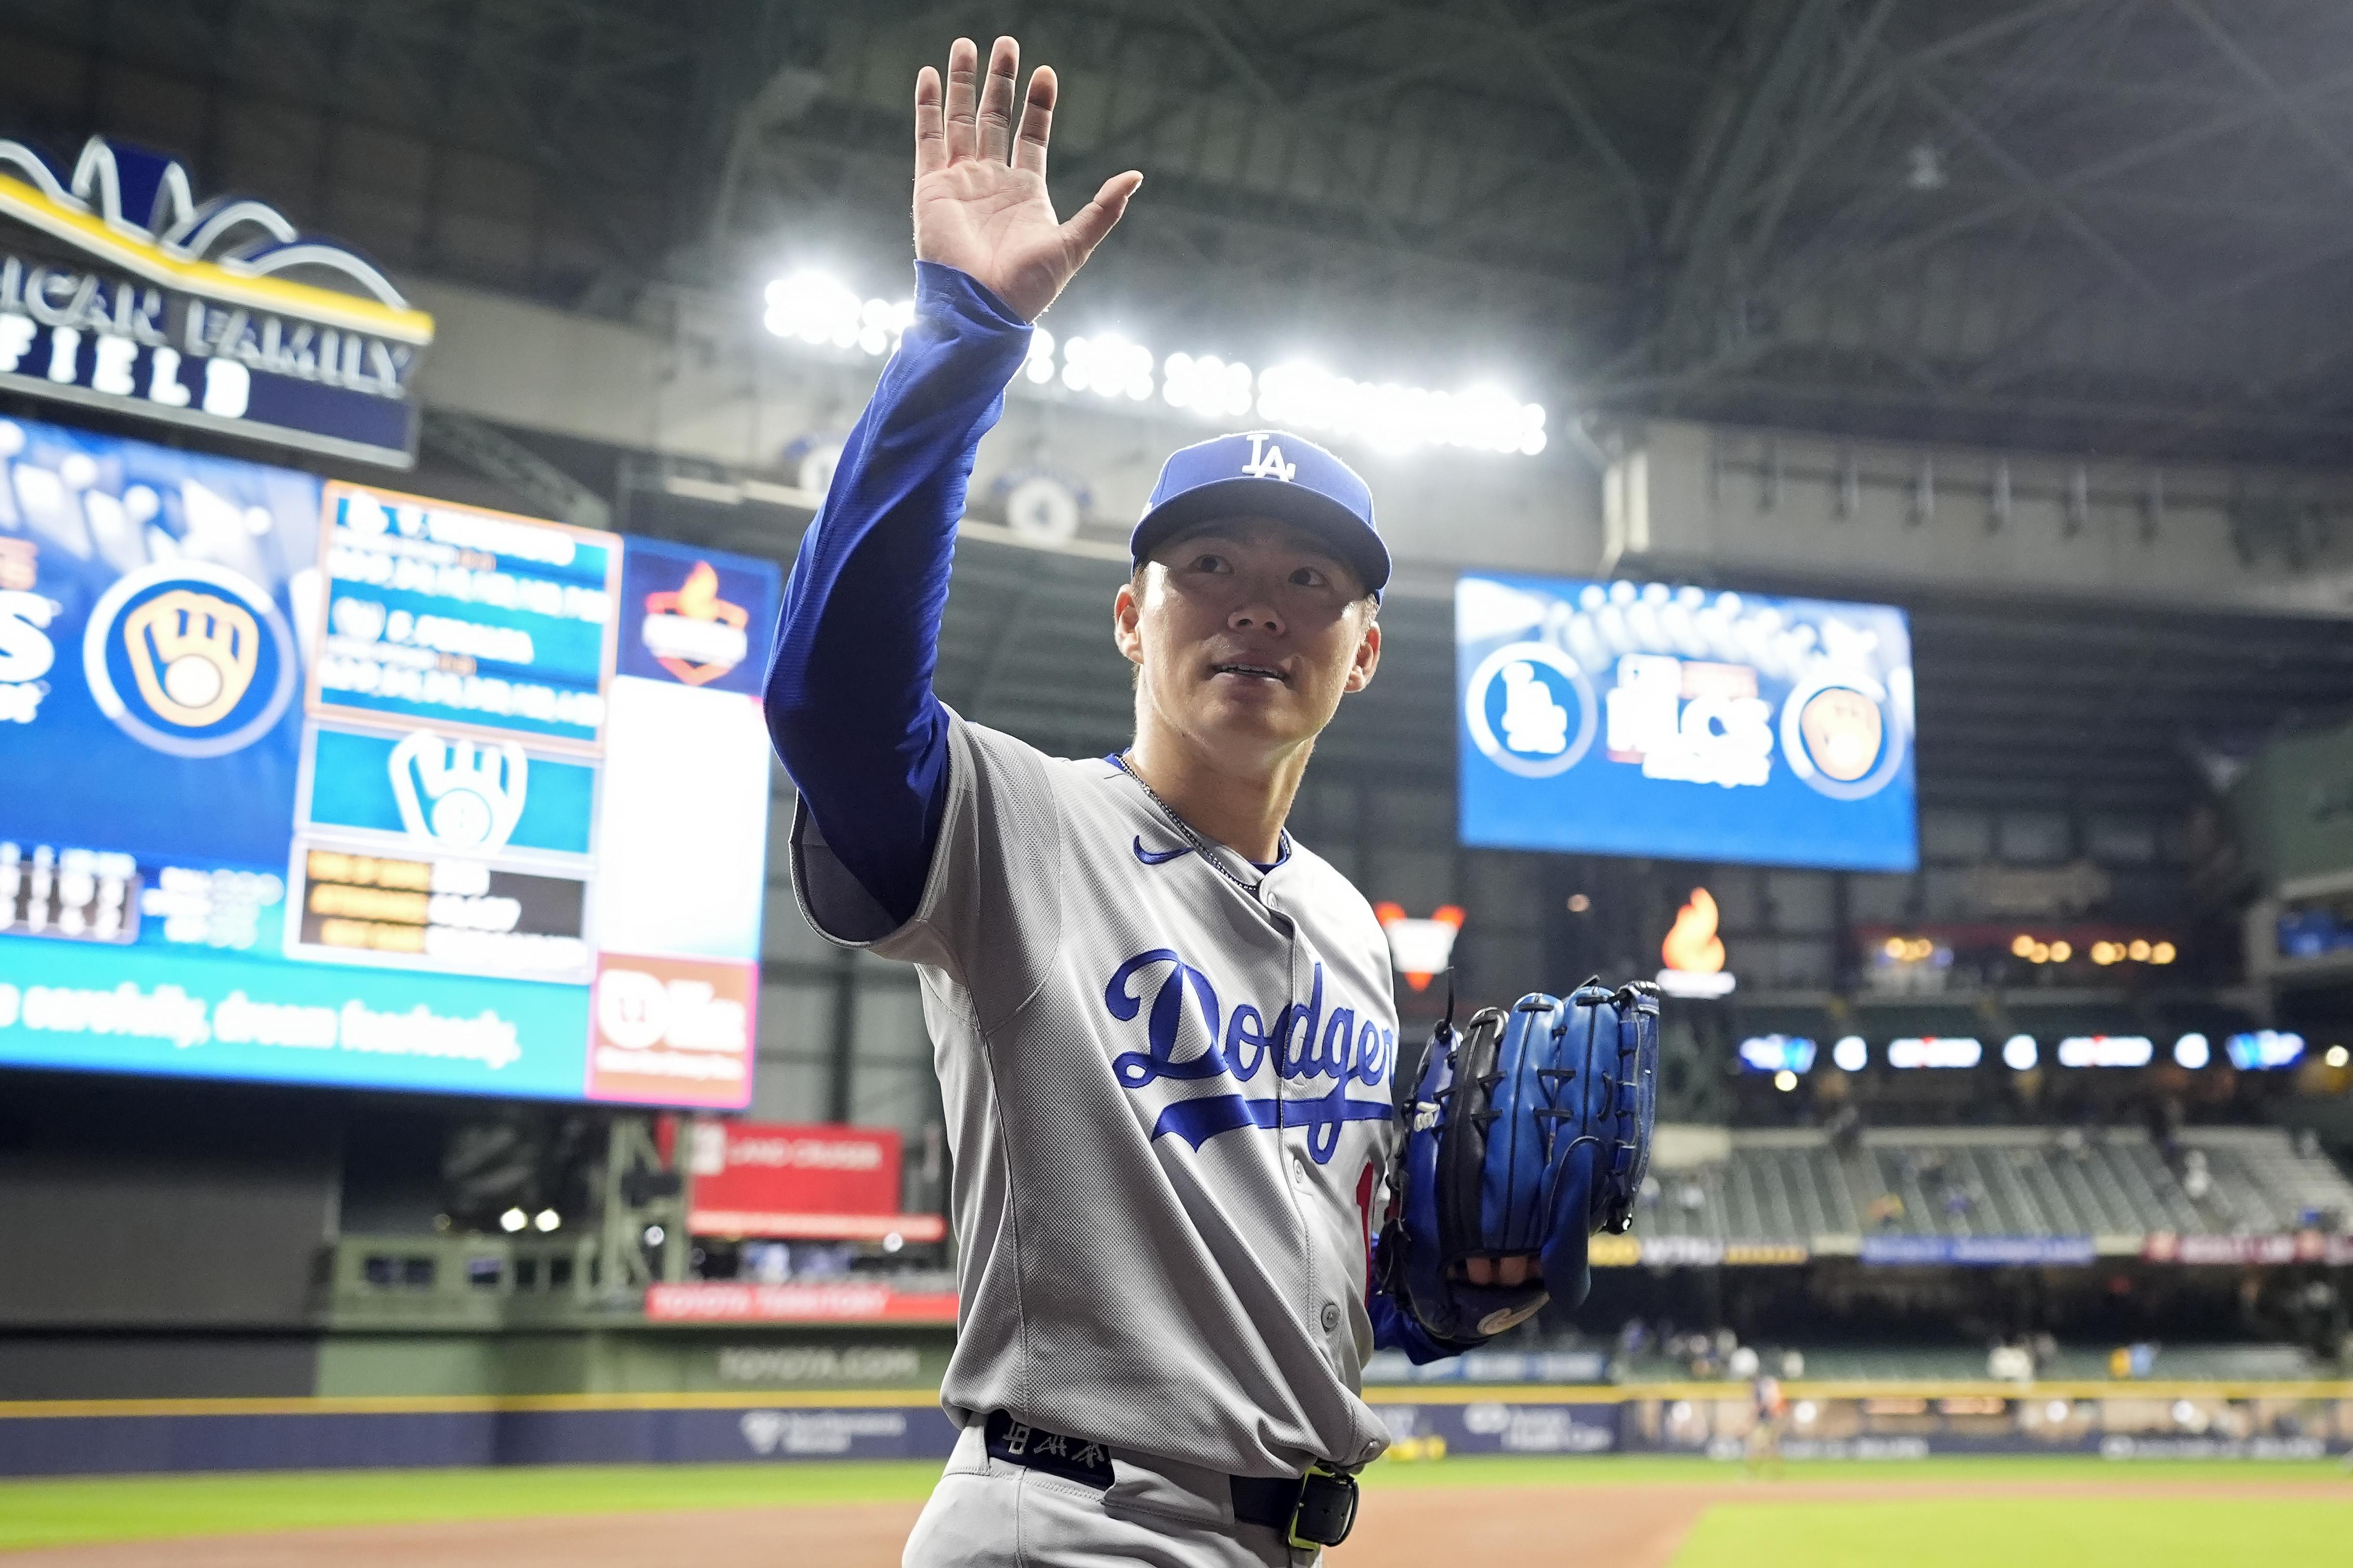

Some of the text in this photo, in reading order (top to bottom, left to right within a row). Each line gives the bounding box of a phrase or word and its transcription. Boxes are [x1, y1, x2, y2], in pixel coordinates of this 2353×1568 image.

[0, 313, 251, 418] FIELD
[185, 298, 411, 399] FAMILY
[1241, 433, 1296, 482] LA
